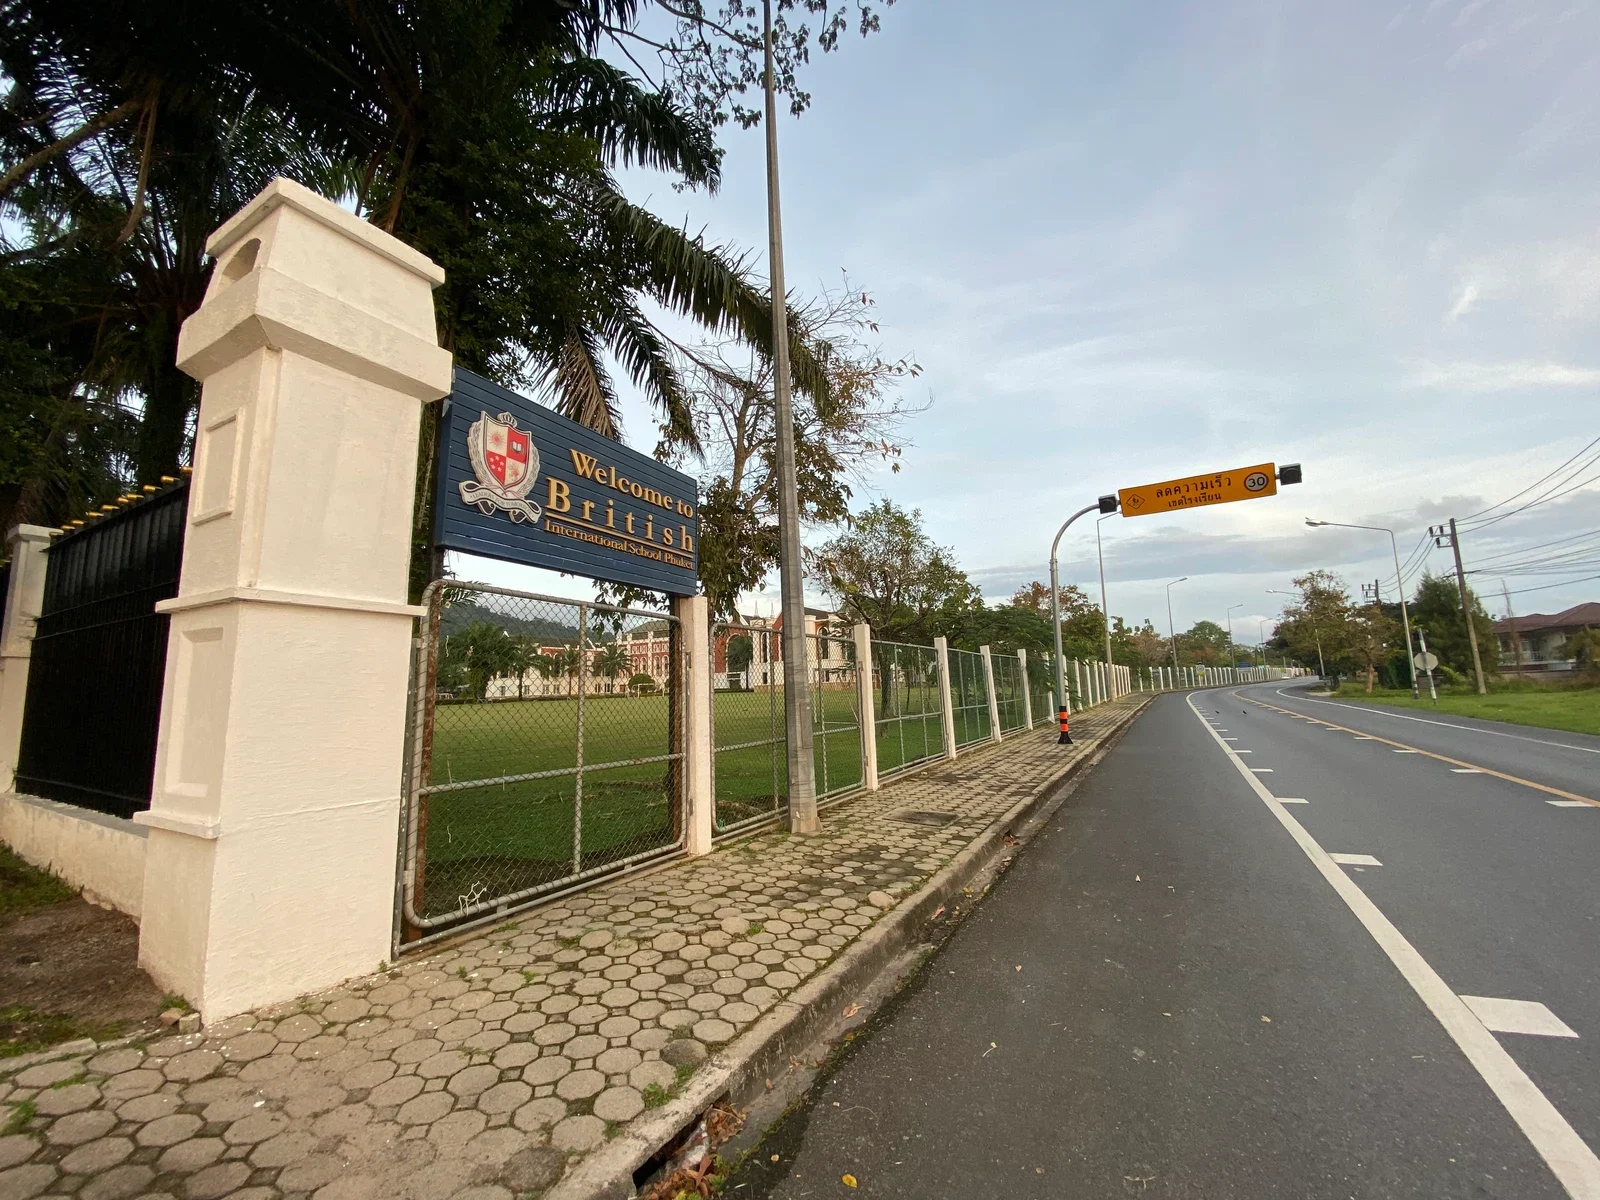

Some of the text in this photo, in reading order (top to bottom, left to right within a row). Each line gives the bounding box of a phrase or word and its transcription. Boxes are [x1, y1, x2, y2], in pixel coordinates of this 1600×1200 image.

[569, 449, 694, 518] Welcome to
[1156, 474, 1232, 498] ลดความเร็ว
[1247, 476, 1266, 488] 30
[545, 477, 694, 553] British
[544, 519, 694, 570] International School Phuket
